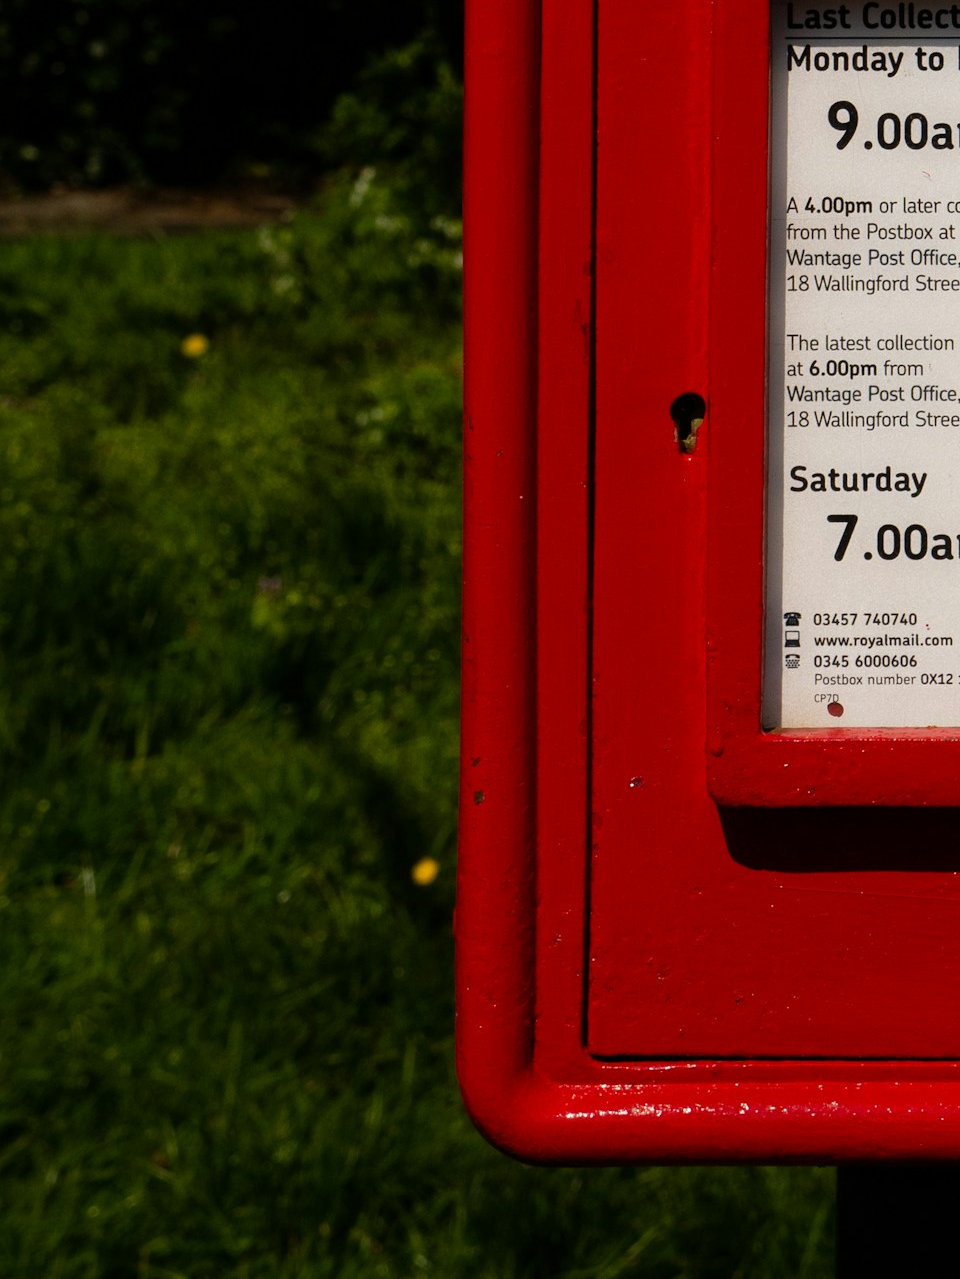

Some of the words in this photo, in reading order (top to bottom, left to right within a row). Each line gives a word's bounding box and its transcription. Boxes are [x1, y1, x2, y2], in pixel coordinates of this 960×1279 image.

[785, 1, 852, 30] Last
[786, 44, 904, 78] Monday
[913, 44, 947, 72] to
[786, 196, 799, 215] A
[804, 196, 873, 218] 4.00pm
[879, 201, 898, 214] or
[903, 196, 942, 214] later
[786, 222, 827, 241] from
[832, 223, 861, 241] the
[867, 222, 933, 240] Postbox
[938, 224, 956, 240] at
[786, 249, 862, 269] Wantage
[868, 248, 906, 266] Post
[786, 274, 810, 292] 18
[813, 274, 910, 296] Wallingford
[786, 333, 819, 352] The
[825, 334, 872, 351] latest
[876, 334, 954, 351] collection
[786, 361, 804, 377] at
[809, 359, 878, 381] 6.00pm
[883, 359, 924, 377] from
[786, 385, 862, 406] Wantage
[868, 384, 905, 402] Post
[786, 410, 810, 428] 18
[813, 410, 910, 431] Wallingford
[789, 465, 928, 499] Saturday
[813, 612, 858, 626] 03457
[863, 612, 918, 626] 740740
[813, 633, 953, 650] www.royalmail.com
[813, 654, 850, 668] 0345
[854, 654, 918, 668] 6000606
[814, 673, 863, 686] Postbox
[867, 673, 917, 685] number
